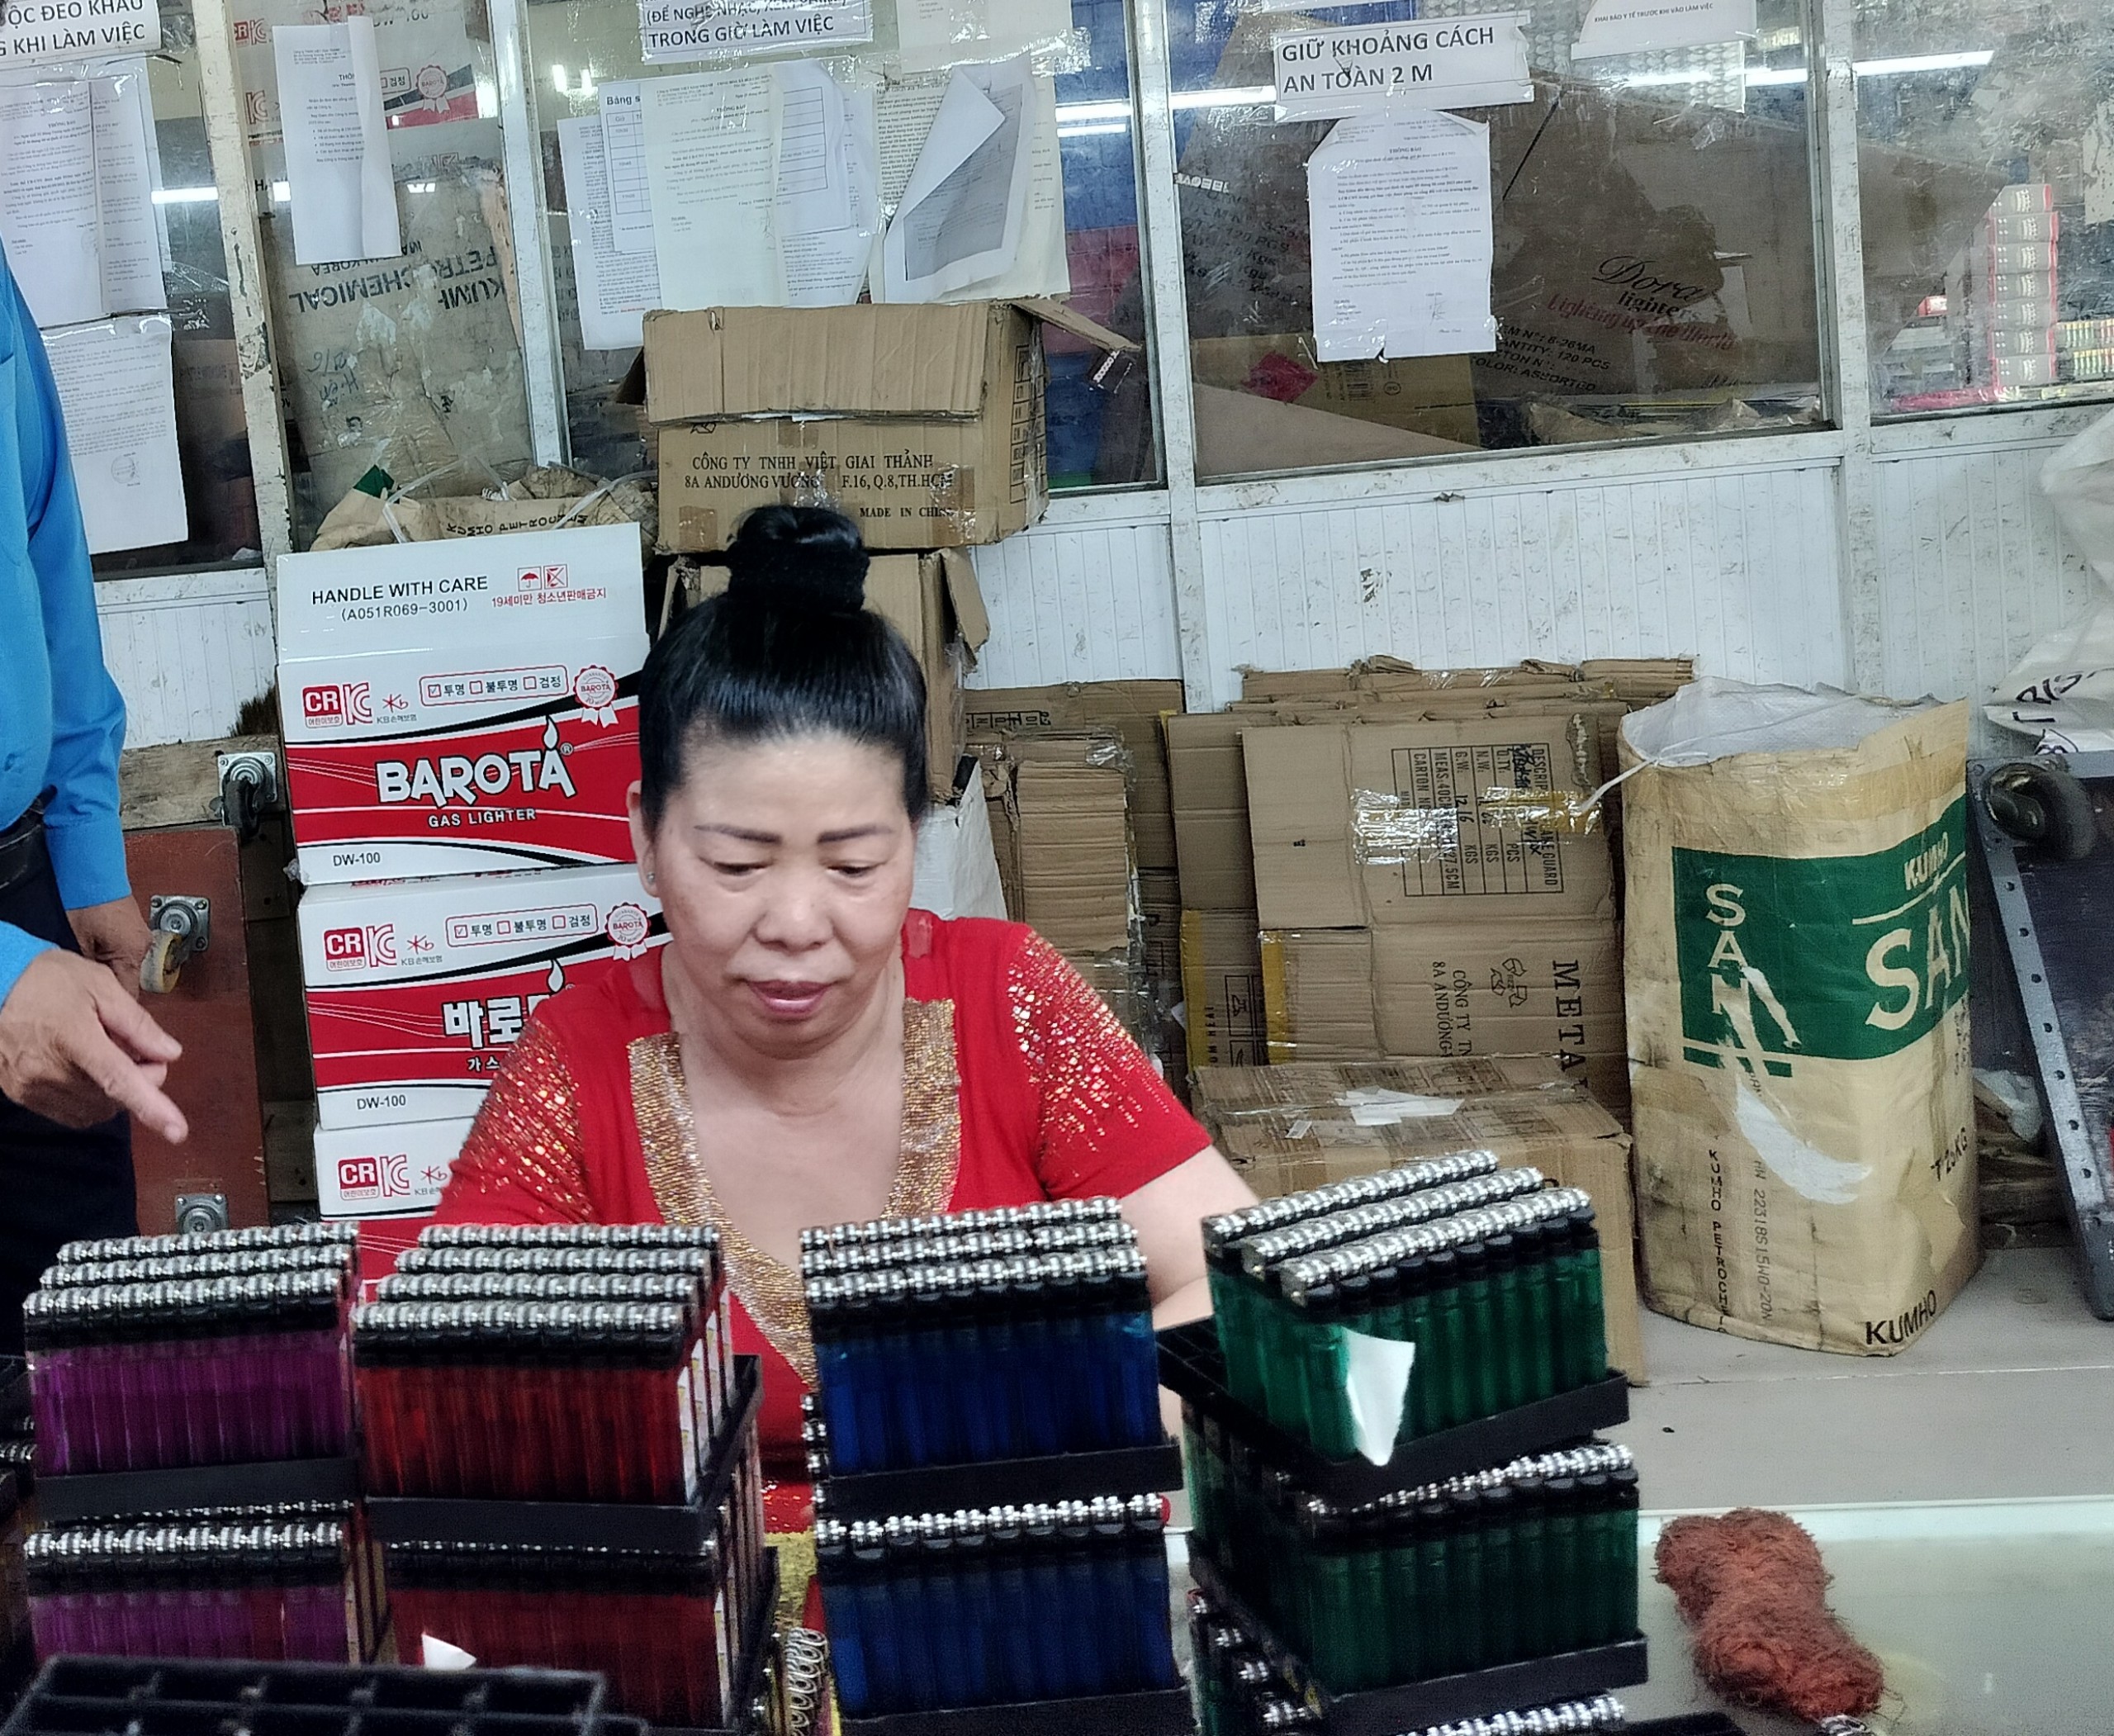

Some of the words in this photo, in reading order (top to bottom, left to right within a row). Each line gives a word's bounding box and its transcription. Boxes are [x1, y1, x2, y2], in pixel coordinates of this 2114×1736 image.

[40, 2, 82, 21] ĐEO
[13, 36, 46, 55] KHI
[53, 28, 96, 50] LÀM
[102, 21, 145, 45] VIỆC
[649, 28, 709, 48] TRONG
[752, 19, 789, 38] LÀM
[795, 12, 834, 34] VIỆC
[1282, 40, 1323, 63] GIỮ
[1332, 30, 1428, 58] KHOẢNG
[1435, 26, 1494, 49] CÁCH
[1283, 74, 1315, 93] AN
[1322, 62, 1385, 90] TOÀN
[1391, 67, 1405, 85] 2
[1412, 64, 1434, 83] M
[1581, 358, 1611, 371] PCS
[692, 452, 728, 470] CÔNG
[733, 457, 751, 470] TY
[759, 456, 796, 469] TNHH
[846, 455, 875, 469] GIAI
[685, 477, 699, 488] 8A
[860, 508, 890, 518] MADE
[900, 508, 912, 517] IN
[447, 522, 493, 537] KUMHO
[312, 585, 383, 605] HANDLE
[388, 581, 433, 600] WITH
[439, 576, 488, 595] CARE
[491, 591, 533, 608] 19세미만
[341, 598, 468, 623] (A051R069-3001)
[444, 683, 466, 697] 투명
[486, 680, 519, 693] 불투명
[539, 676, 562, 688] 검정
[305, 690, 339, 712] CR
[376, 747, 576, 808] BAROTA
[1414, 753, 1429, 791] CARTON
[429, 812, 461, 828] GAS
[468, 808, 537, 825] LIGHTER
[333, 851, 381, 866] DW-100
[1464, 845, 1477, 864] KGS
[1486, 844, 1499, 863] KGS
[1506, 843, 1519, 862] PCS
[1543, 853, 1558, 885] GUARD
[471, 923, 493, 937] 투명
[514, 918, 547, 933] 불투명
[569, 914, 590, 928] 검정
[613, 918, 643, 931] BAROTA
[326, 933, 362, 956] CR
[1433, 961, 1446, 977] 8A
[1453, 970, 1472, 1008] CÔNG
[1457, 1014, 1471, 1031] TY
[1552, 960, 1589, 1092] META
[357, 1095, 406, 1110] DW-100
[341, 1163, 376, 1184] CR
[1866, 1289, 1937, 1345] KUMHO
